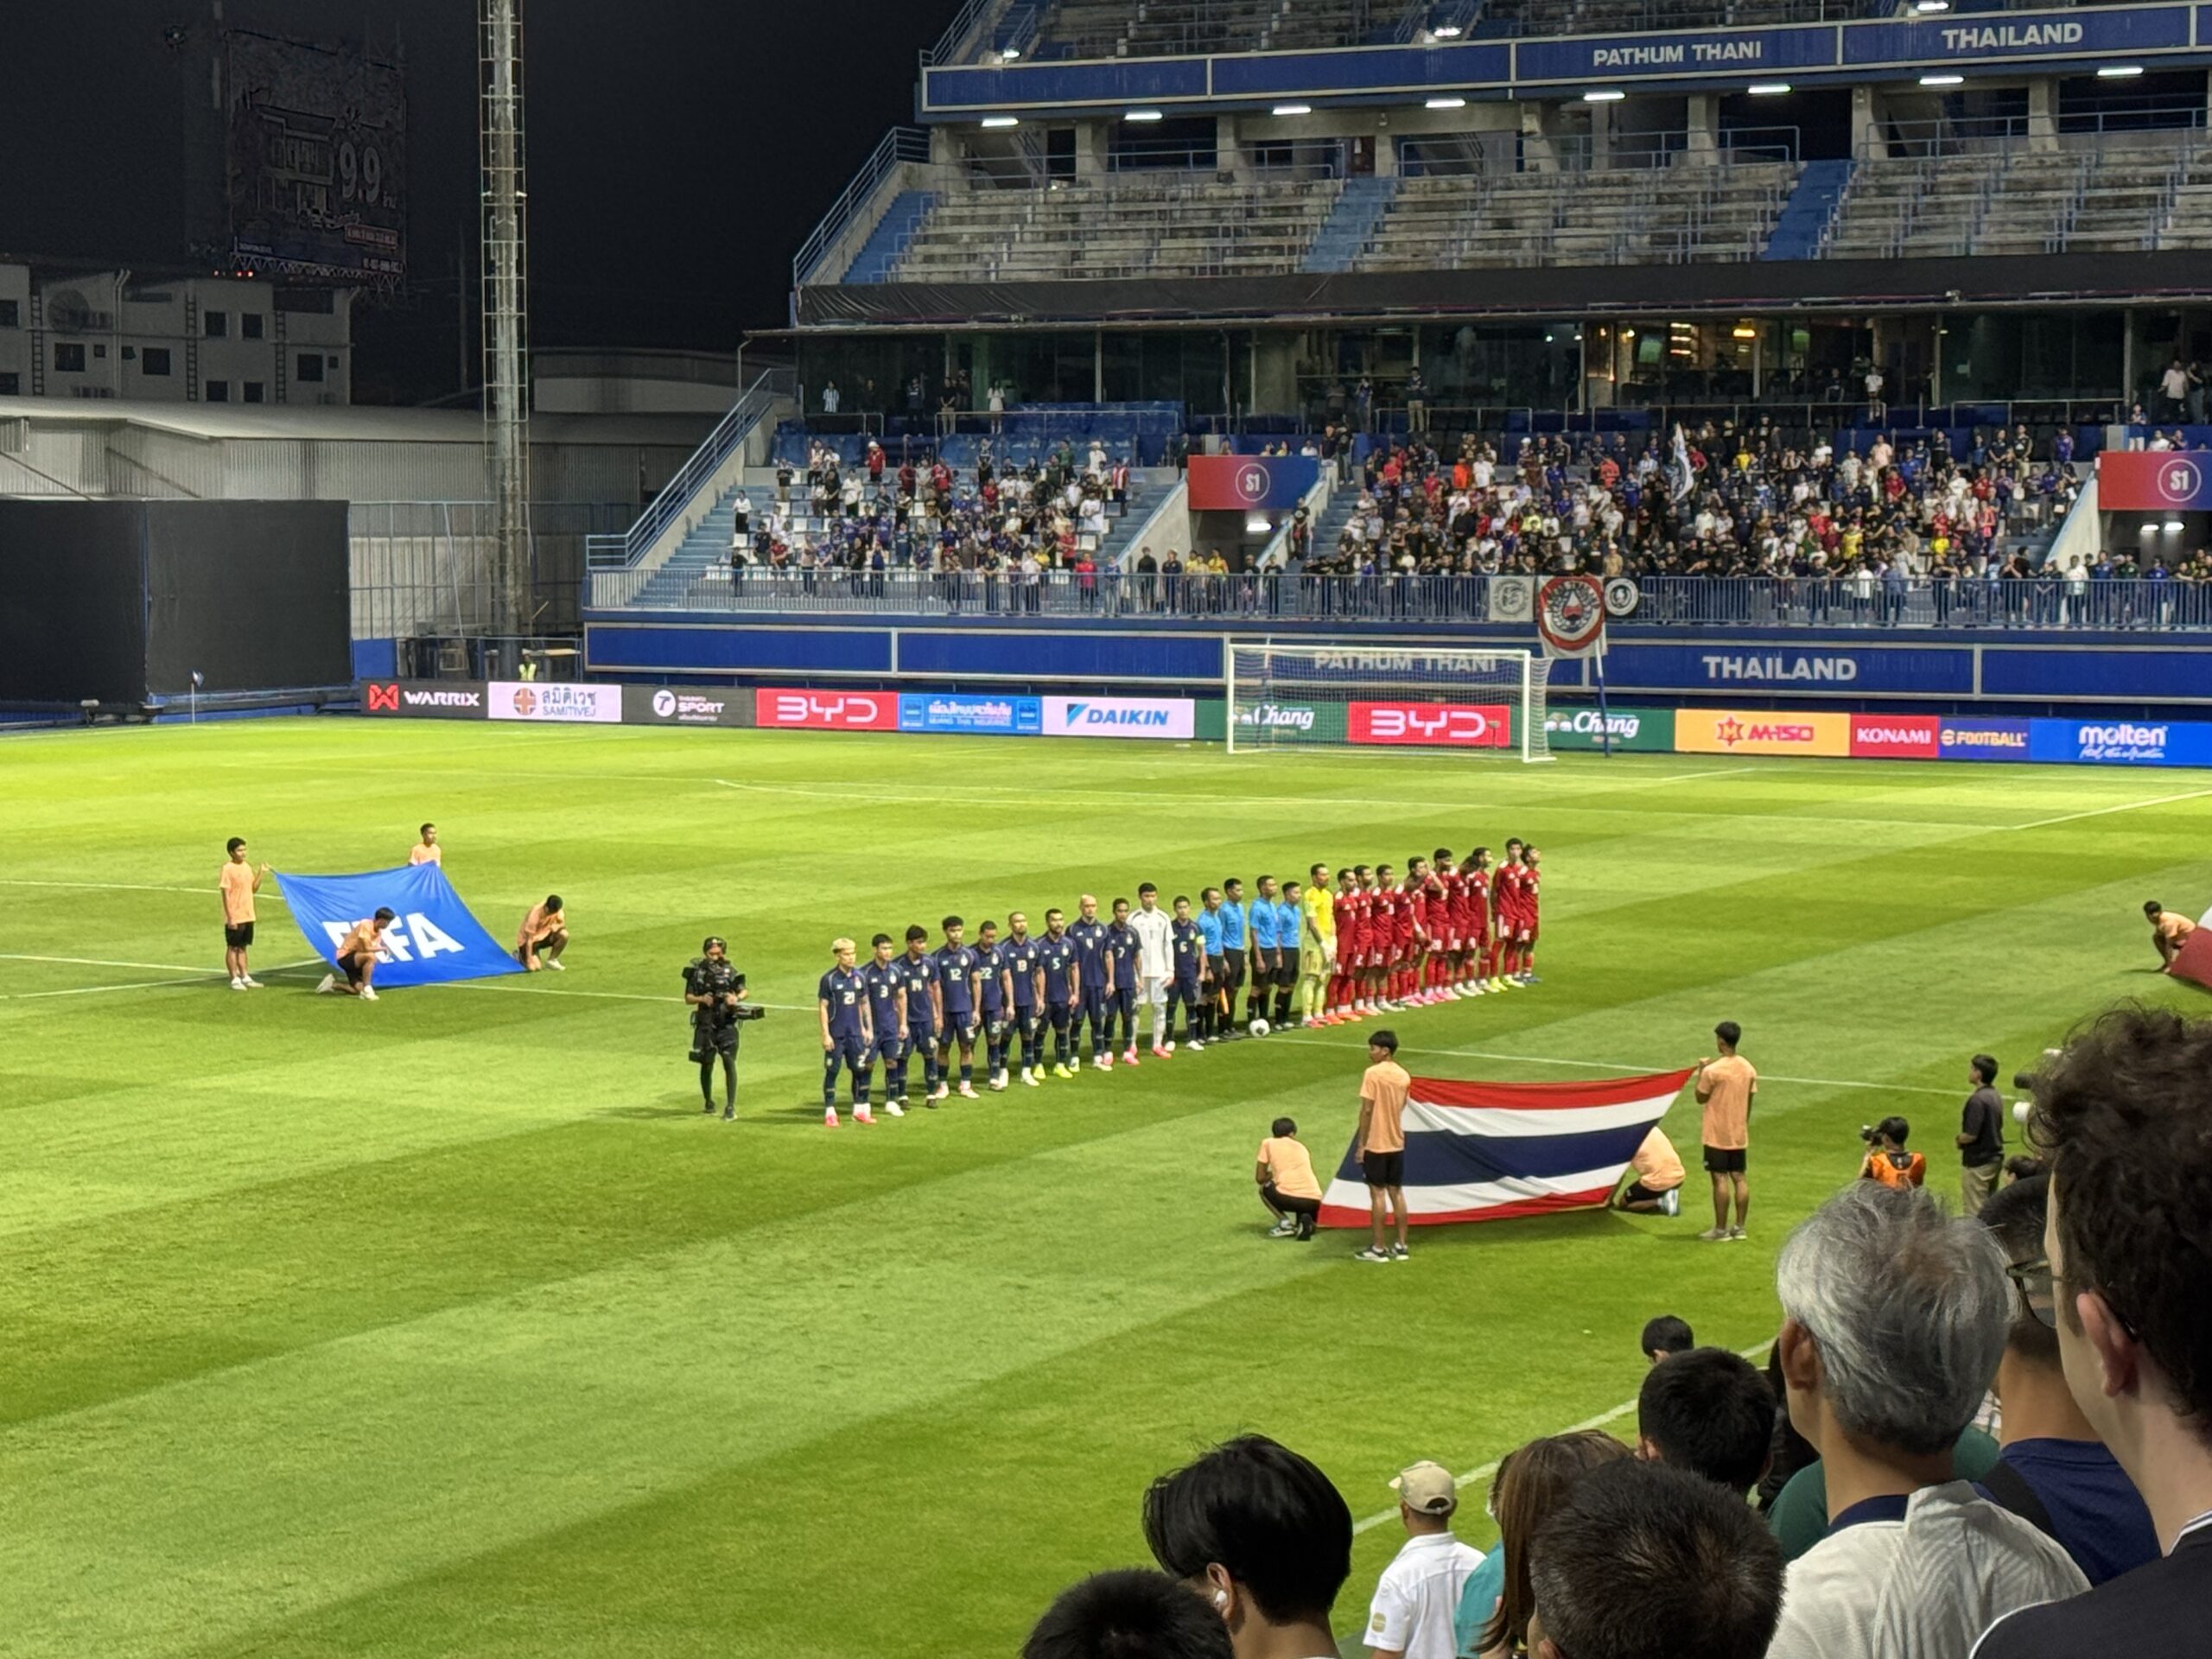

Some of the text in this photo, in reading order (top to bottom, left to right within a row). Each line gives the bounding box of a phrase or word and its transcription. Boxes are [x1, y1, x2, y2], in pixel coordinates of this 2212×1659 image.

[1941, 22, 2083, 49] THAILAND
[1593, 41, 1762, 67] PATHUM THANI
[1246, 474, 1260, 492] S1
[2170, 470, 2189, 491] S1
[1314, 652, 1497, 672] PATHUM THANI
[1702, 656, 1857, 680] THAILAND
[404, 691, 480, 707] WARRIX
[543, 705, 596, 717] SAMITIVEJ
[677, 702, 725, 714] SPORT
[777, 696, 878, 722] BYD
[1254, 703, 1315, 730] Chang
[1086, 709, 1169, 726] DAIKIN
[1370, 709, 1486, 738] BYD
[1573, 711, 1640, 738] Chang
[1857, 728, 1931, 745] KONAMI
[2078, 724, 2167, 747] molten
[1117, 947, 1126, 958] 7
[1179, 941, 1189, 953] 6
[1052, 957, 1061, 969] 5
[950, 968, 962, 981] 12
[980, 967, 993, 980] 22
[843, 991, 855, 1005] 21
[880, 984, 889, 998] 3
